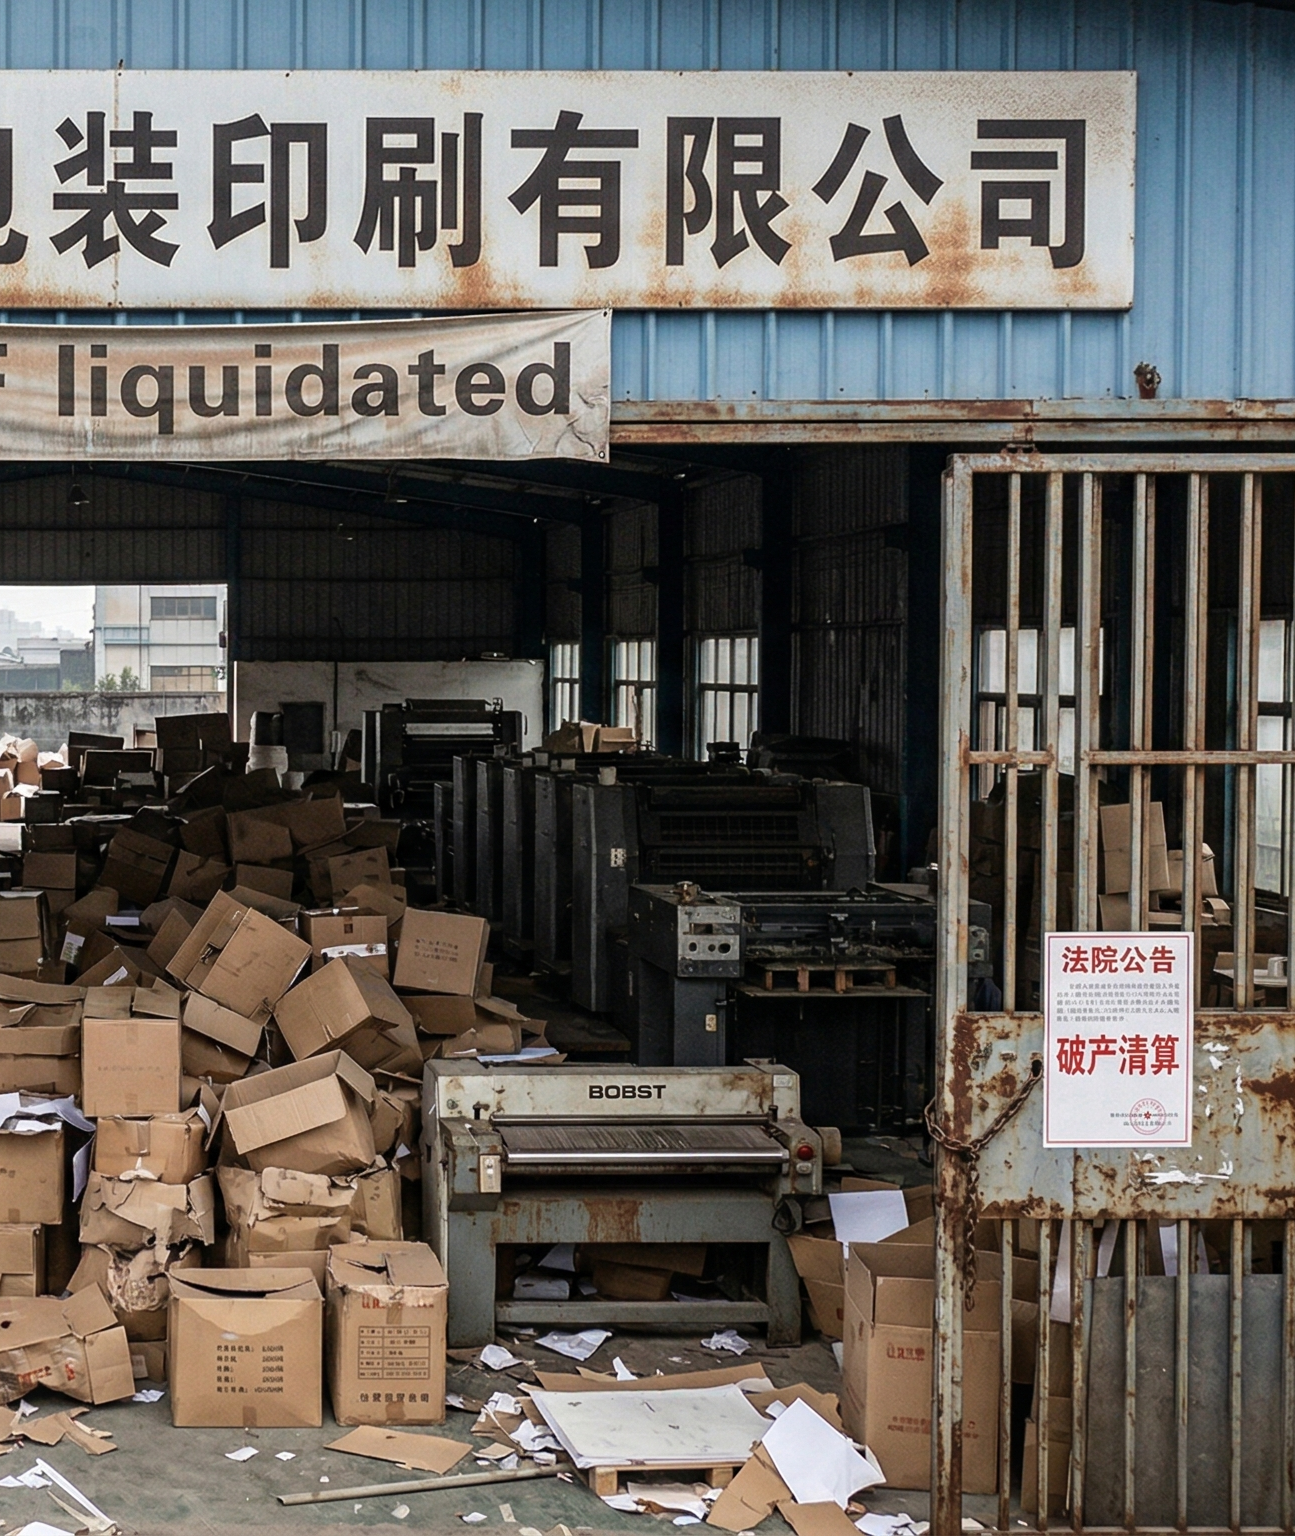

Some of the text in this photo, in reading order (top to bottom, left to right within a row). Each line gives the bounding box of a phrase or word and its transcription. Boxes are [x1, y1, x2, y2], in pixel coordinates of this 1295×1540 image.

[58, 341, 571, 435] liquidated
[1062, 945, 1176, 974] 法院公告
[1056, 1034, 1180, 1076] 破产清算
[588, 1084, 667, 1100] BOBST
